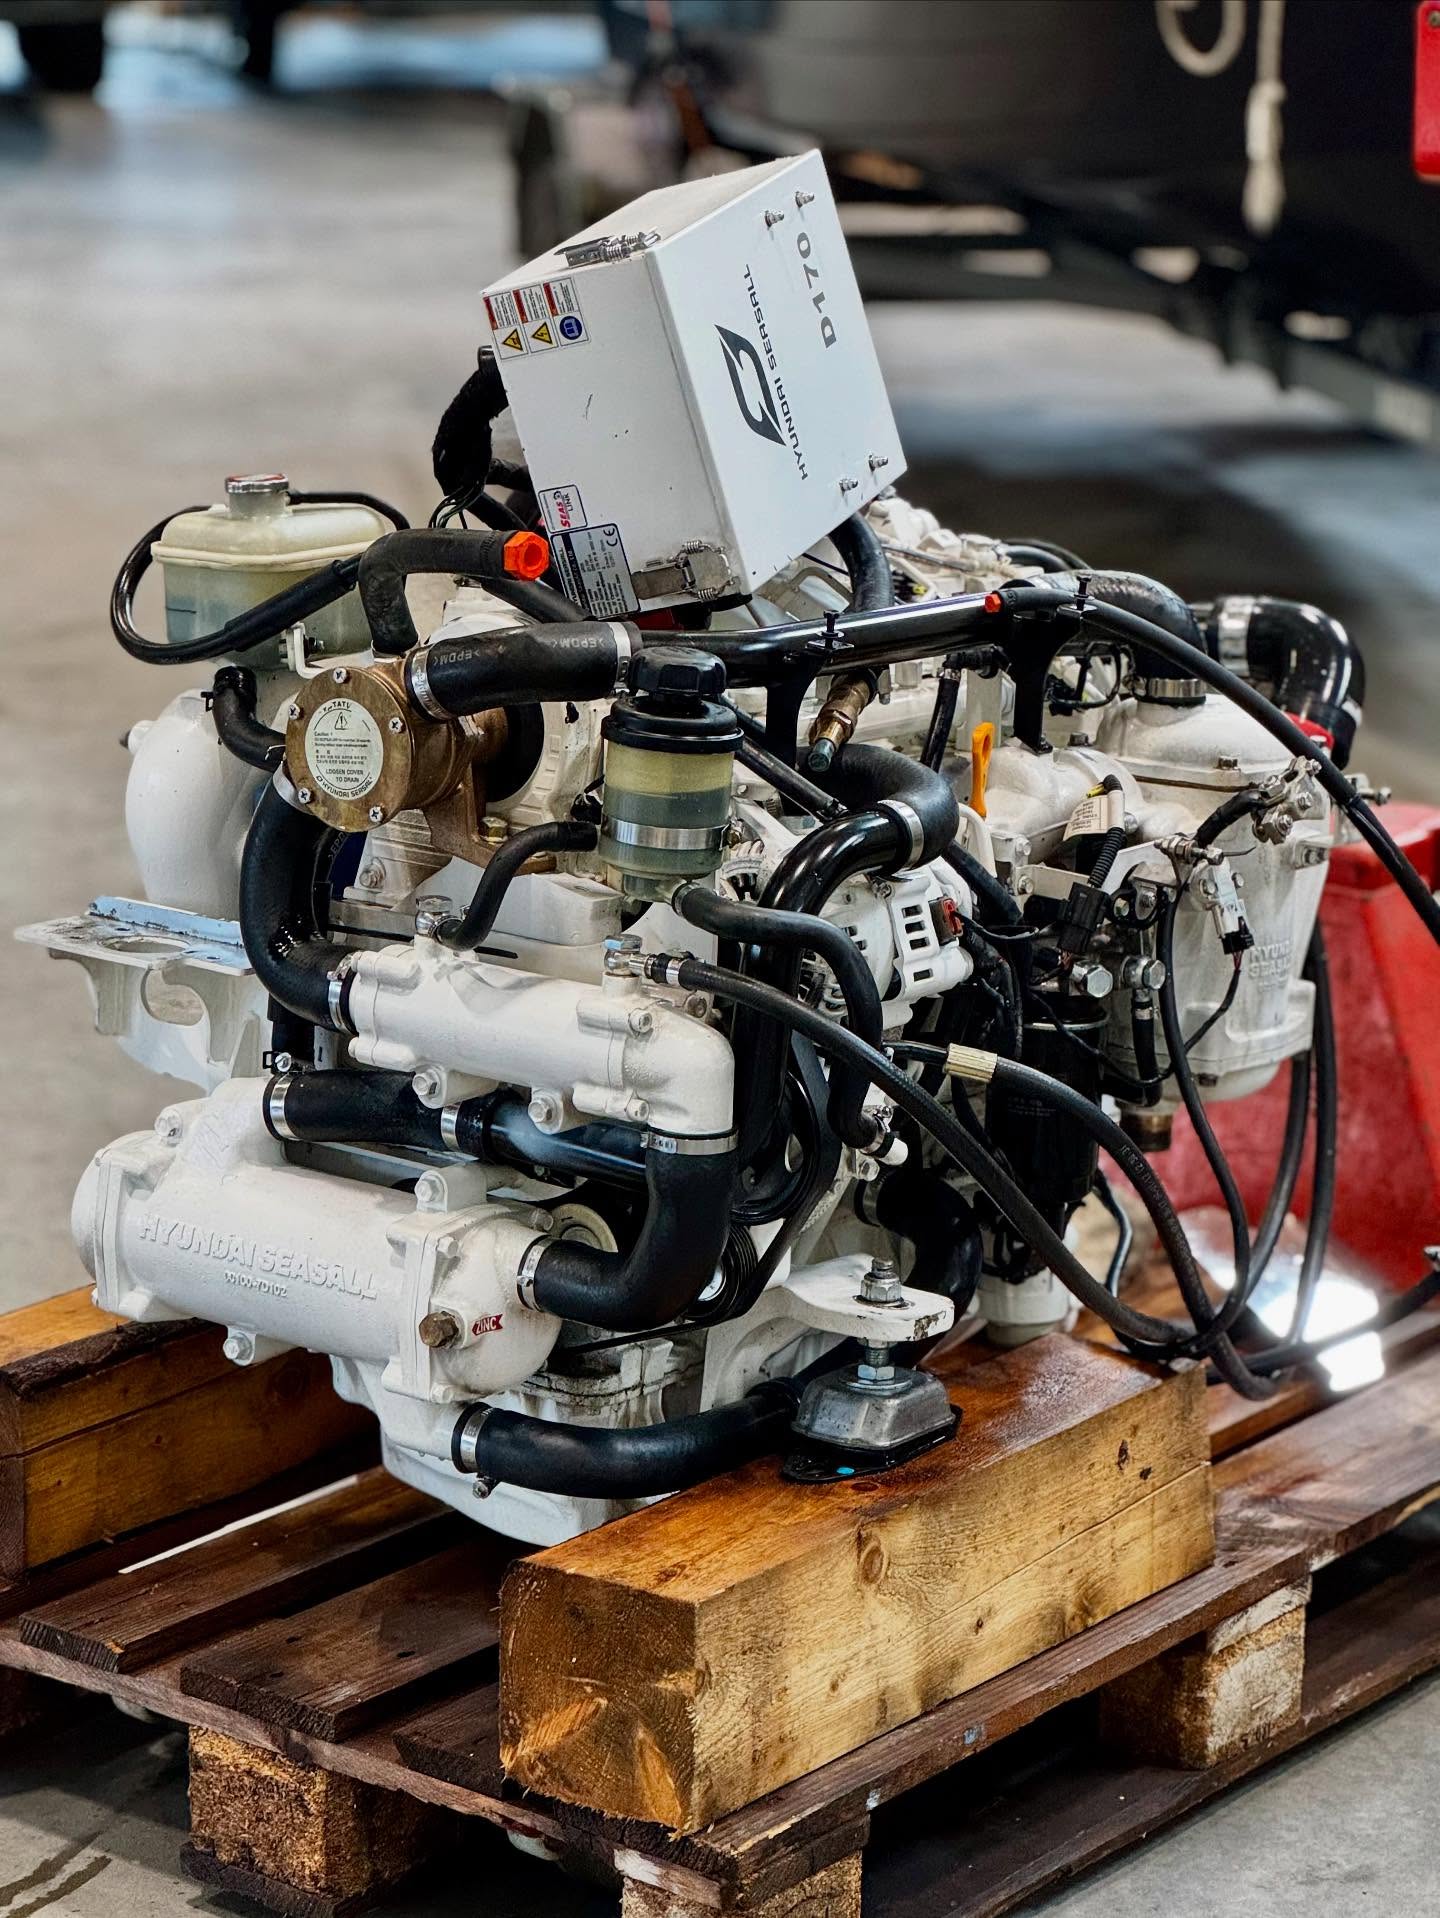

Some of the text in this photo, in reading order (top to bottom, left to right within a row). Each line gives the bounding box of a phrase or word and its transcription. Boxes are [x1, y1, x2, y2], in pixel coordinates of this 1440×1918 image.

[797, 232, 837, 349] D170
[743, 263, 809, 481] HYUNDAI SEASALL
[556, 501, 571, 528] SEAS
[563, 493, 573, 512] LINK
[322, 780, 350, 798] HYUNDAI
[139, 1216, 378, 1300] HYUNDAI SEASALL
[475, 1316, 497, 1335] ZINC
